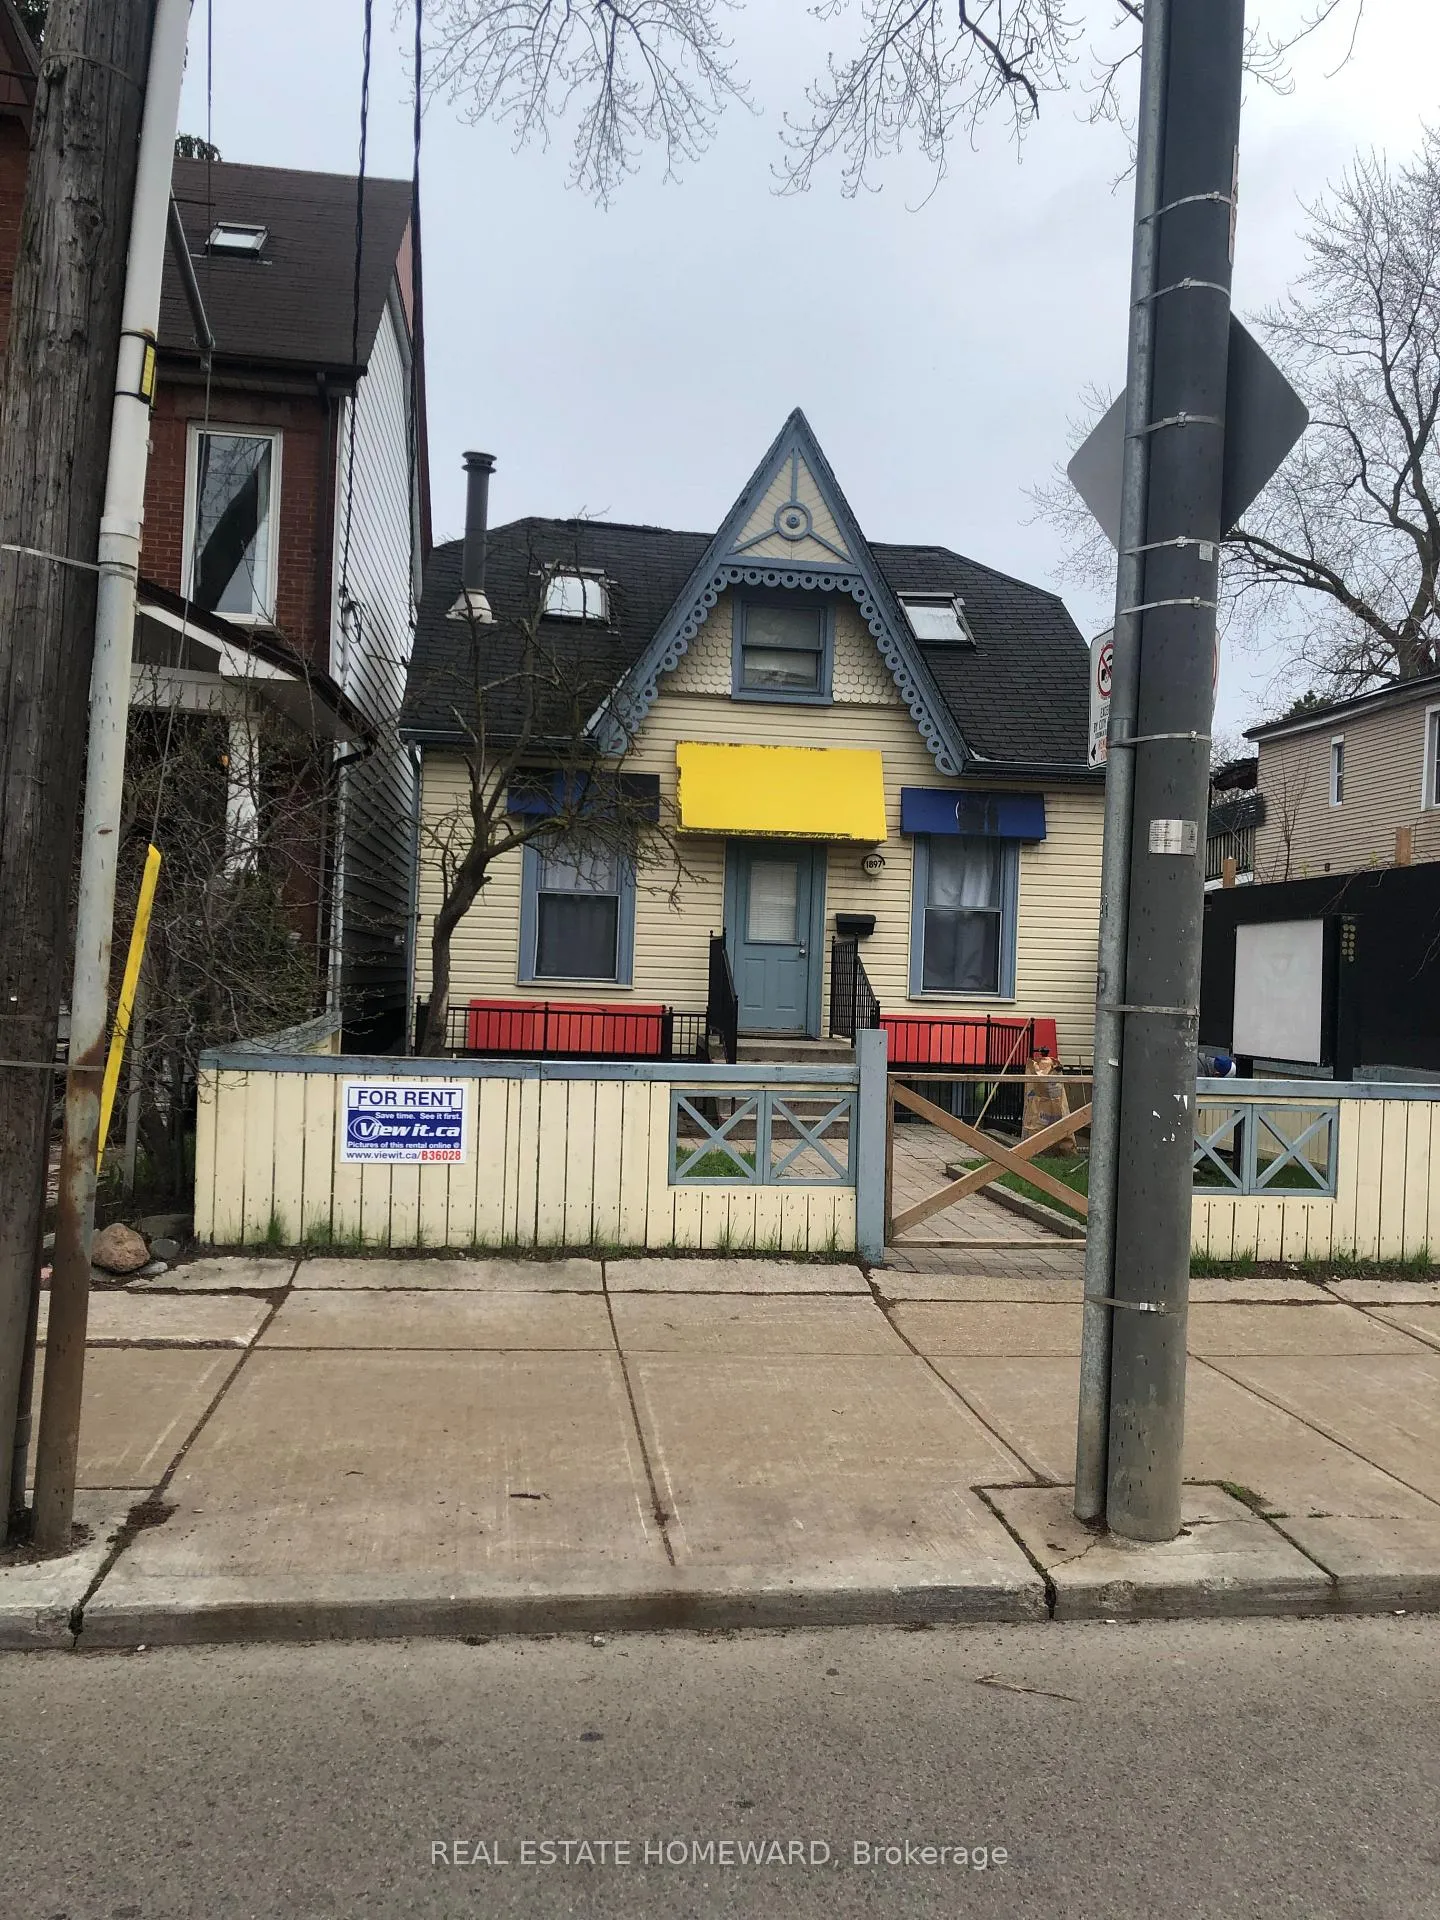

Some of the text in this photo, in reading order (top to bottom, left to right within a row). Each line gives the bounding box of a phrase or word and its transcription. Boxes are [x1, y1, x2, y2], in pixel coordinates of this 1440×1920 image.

[866, 860, 882, 868] 1897
[358, 1090, 456, 1106] FOR RENT
[420, 1112, 435, 1120] See
[360, 1122, 411, 1137] View
[347, 1141, 379, 1149] Pictures
[380, 1141, 389, 1149] of
[389, 1141, 404, 1149] this
[405, 1141, 427, 1149] rental
